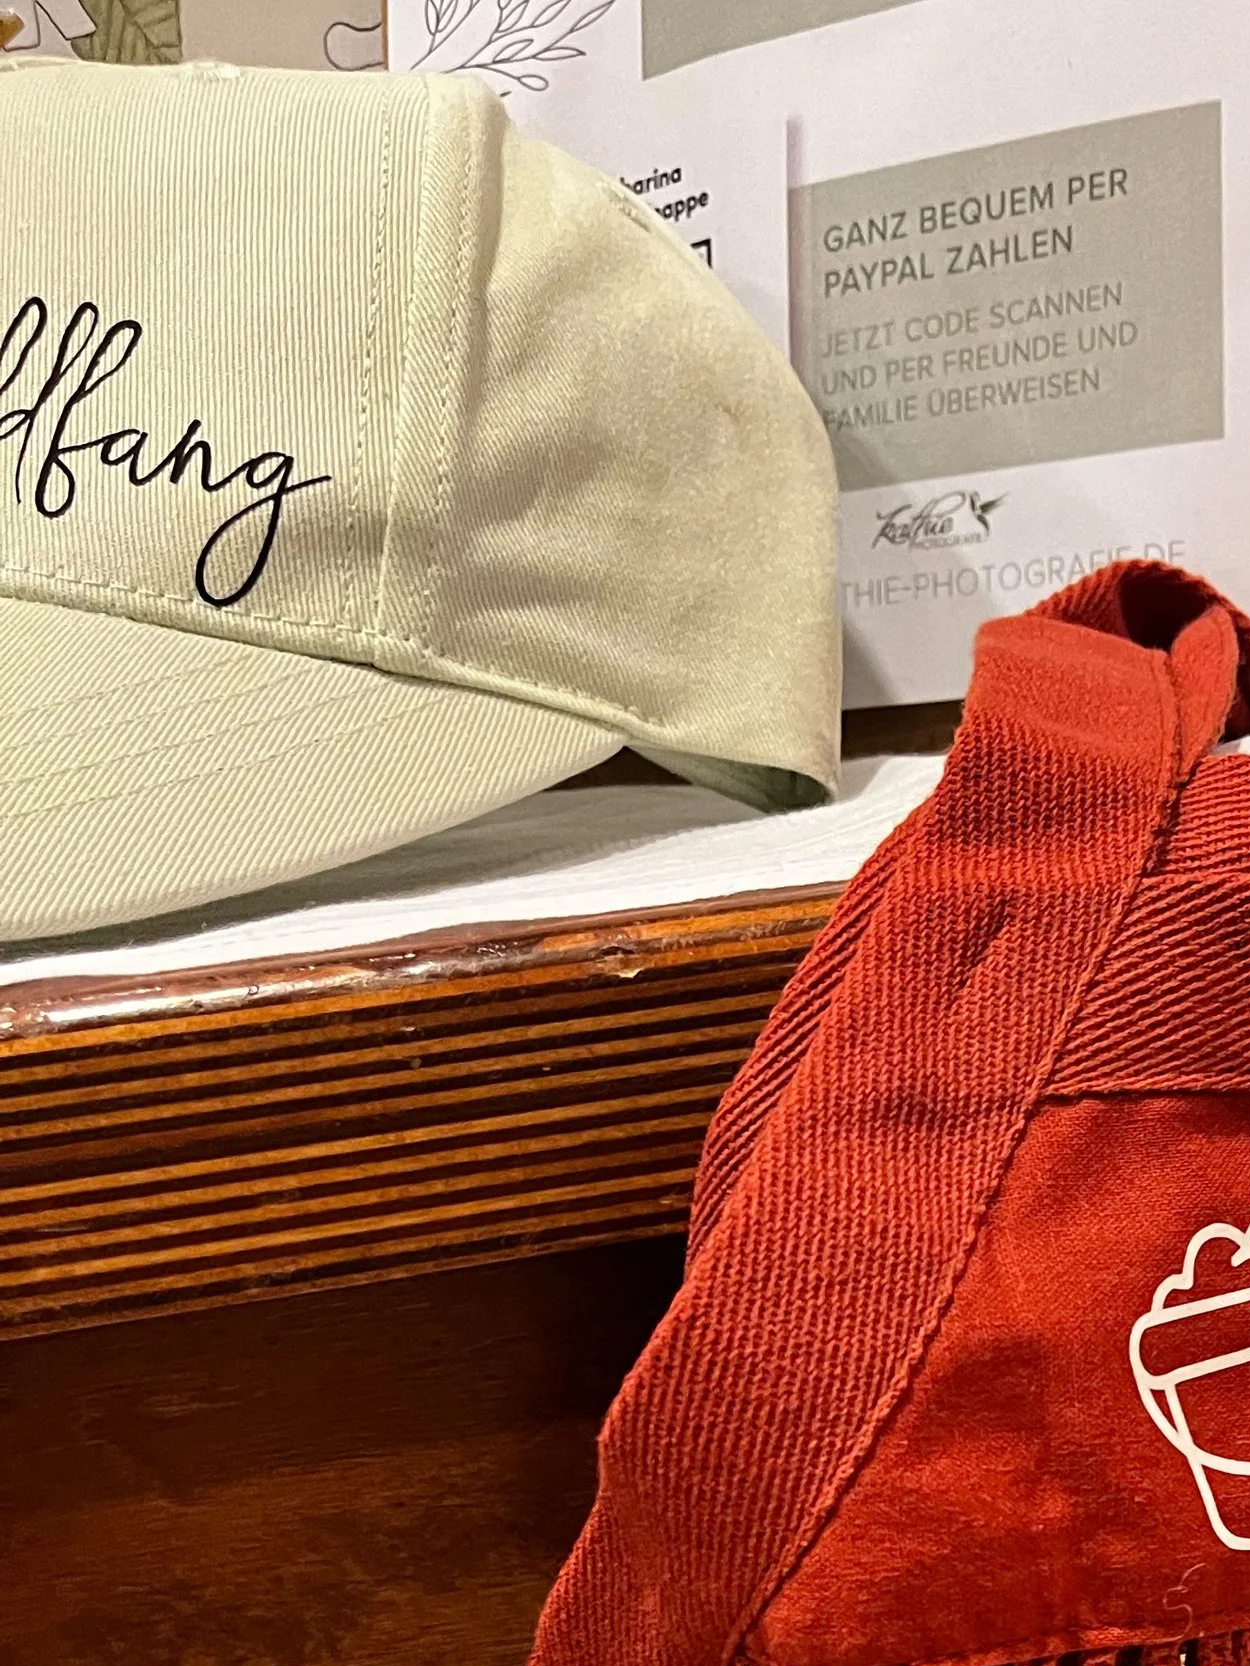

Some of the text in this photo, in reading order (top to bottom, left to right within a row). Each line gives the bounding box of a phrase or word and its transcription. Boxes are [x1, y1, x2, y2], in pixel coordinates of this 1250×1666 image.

[823, 168, 1128, 253] GANZ BEQUEM PER
[824, 225, 1074, 298] PAYPAL ZAHLEN
[822, 281, 1123, 359] JETZT CODE SCANNEN
[822, 320, 1138, 396] UND PER FREUNDE UND
[822, 395, 917, 432] FAMILIE
